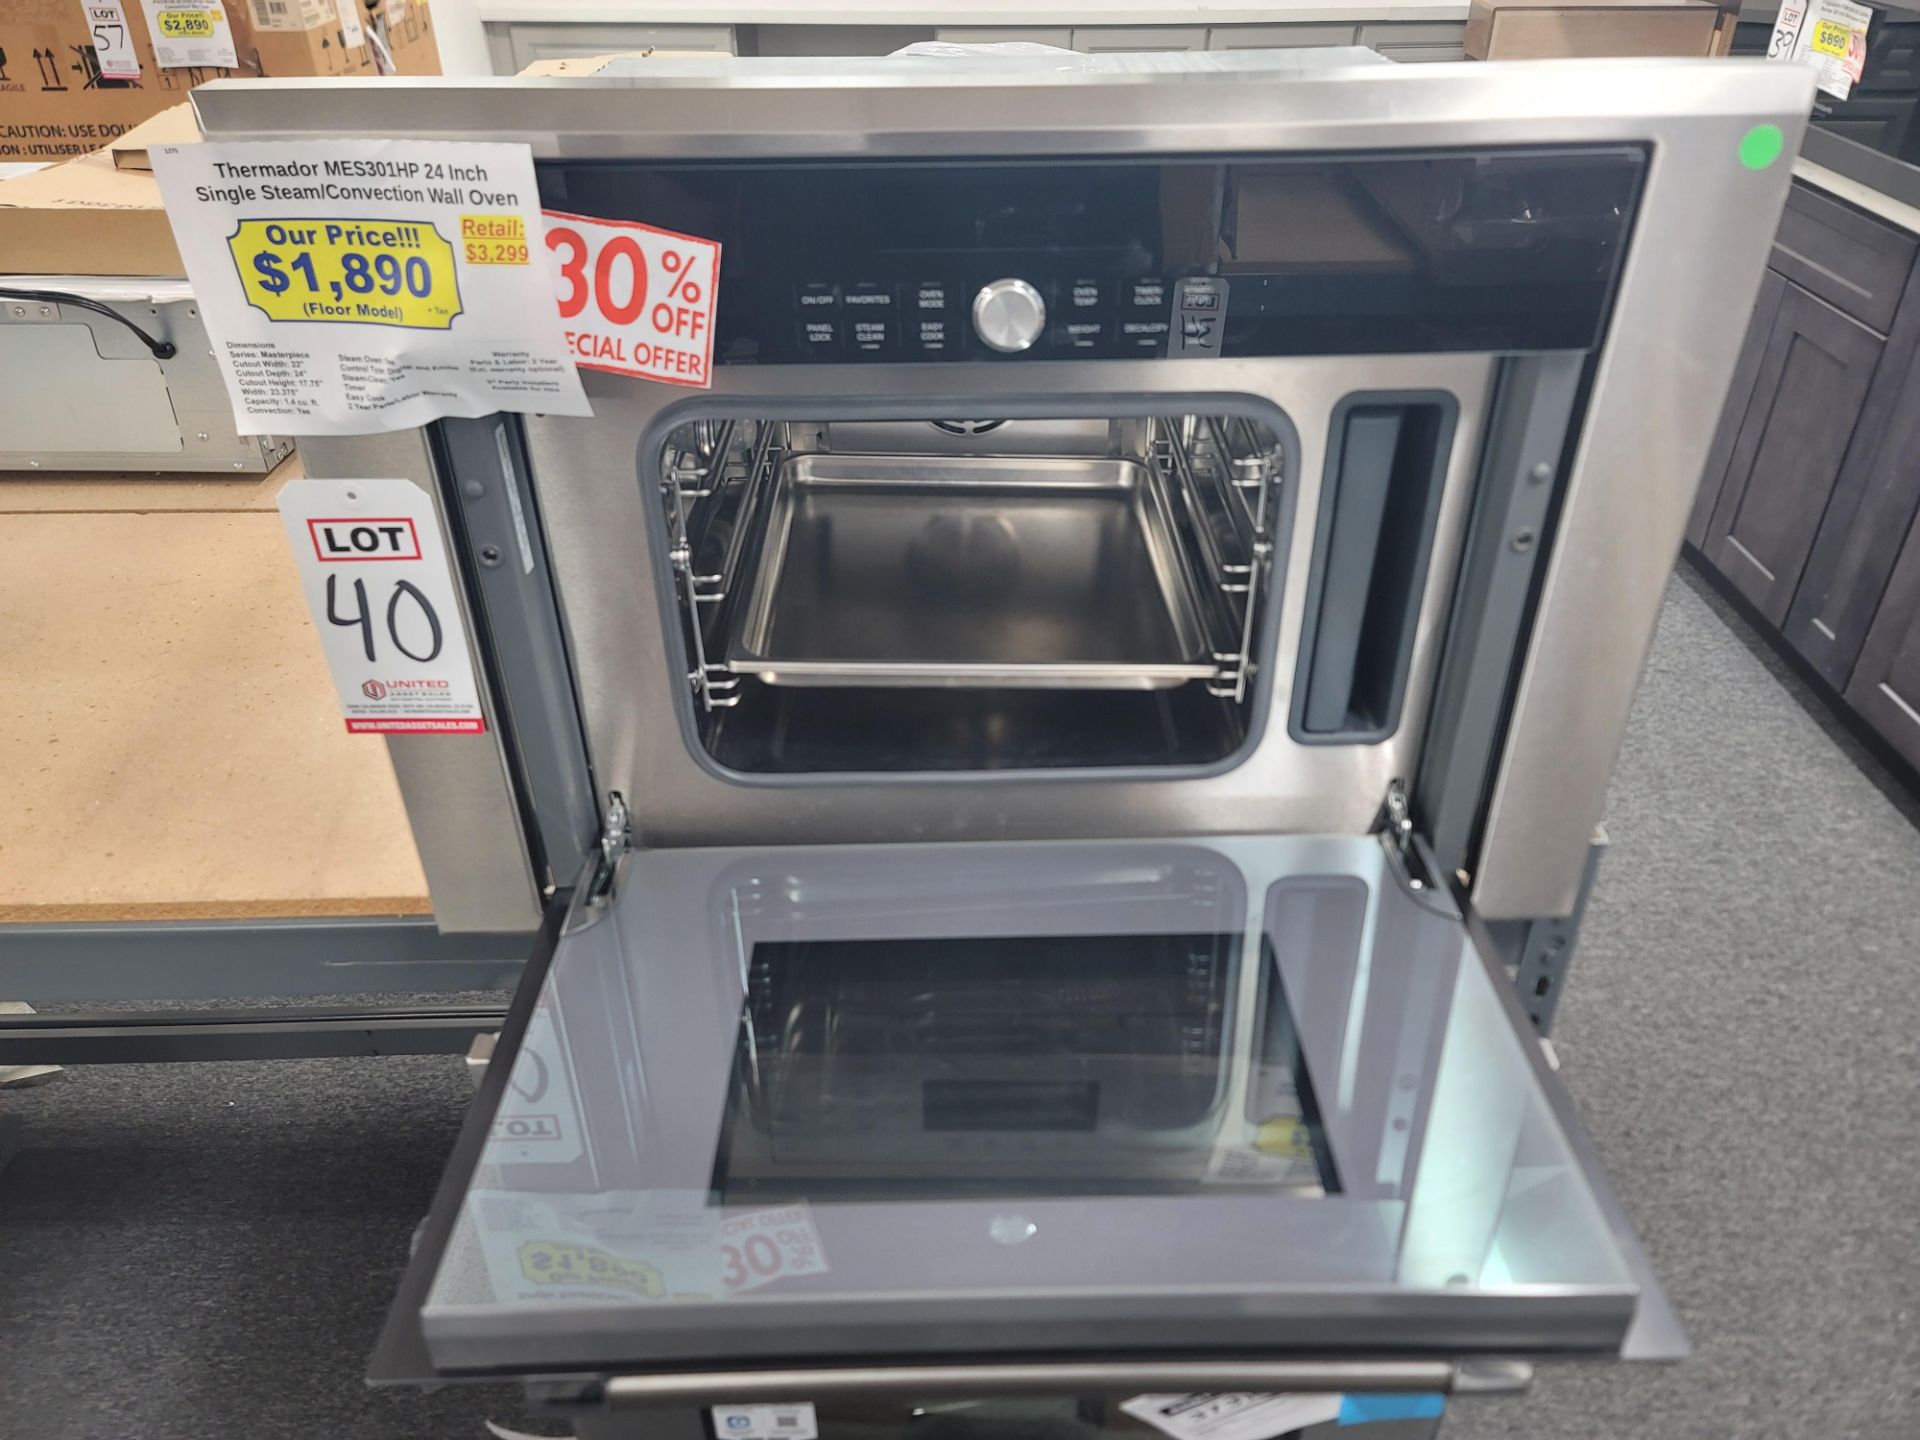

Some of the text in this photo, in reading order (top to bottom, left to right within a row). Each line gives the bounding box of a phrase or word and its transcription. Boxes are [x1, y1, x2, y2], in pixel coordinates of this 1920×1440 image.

[93, 10, 115, 19] LOT
[1784, 12, 1798, 22] LOT
[164, 19, 209, 32] $2,890
[94, 24, 123, 51] 57
[1820, 31, 1846, 49] $890
[69, 124, 97, 137] USE
[28, 144, 81, 155] UTILISER
[213, 161, 488, 181] Thermador MES301HP 24 Inch
[195, 183, 519, 206] Single Steam/Convection Wall Oven
[462, 218, 525, 236] Retail:
[266, 225, 421, 248] Our Price!!!
[466, 243, 529, 262] $3,299
[253, 250, 432, 302] $1,890
[919, 289, 944, 299] OVEN
[303, 302, 403, 322] (Floor Model)
[652, 302, 705, 339] OFF
[226, 341, 276, 349] Dimensions
[260, 351, 310, 359] Masterpiece
[634, 342, 702, 375] OFFER
[232, 360, 261, 368] Cutout
[262, 360, 290, 368] Width:
[235, 369, 264, 377] Cutout
[265, 369, 292, 378] Depth:
[268, 379, 296, 387] Height:
[344, 383, 366, 391] Timer
[244, 397, 283, 405] Capacity:
[247, 406, 294, 414] Convection:
[323, 527, 404, 552] LOT
[326, 573, 442, 663] 40
[385, 680, 449, 689] UNITED
